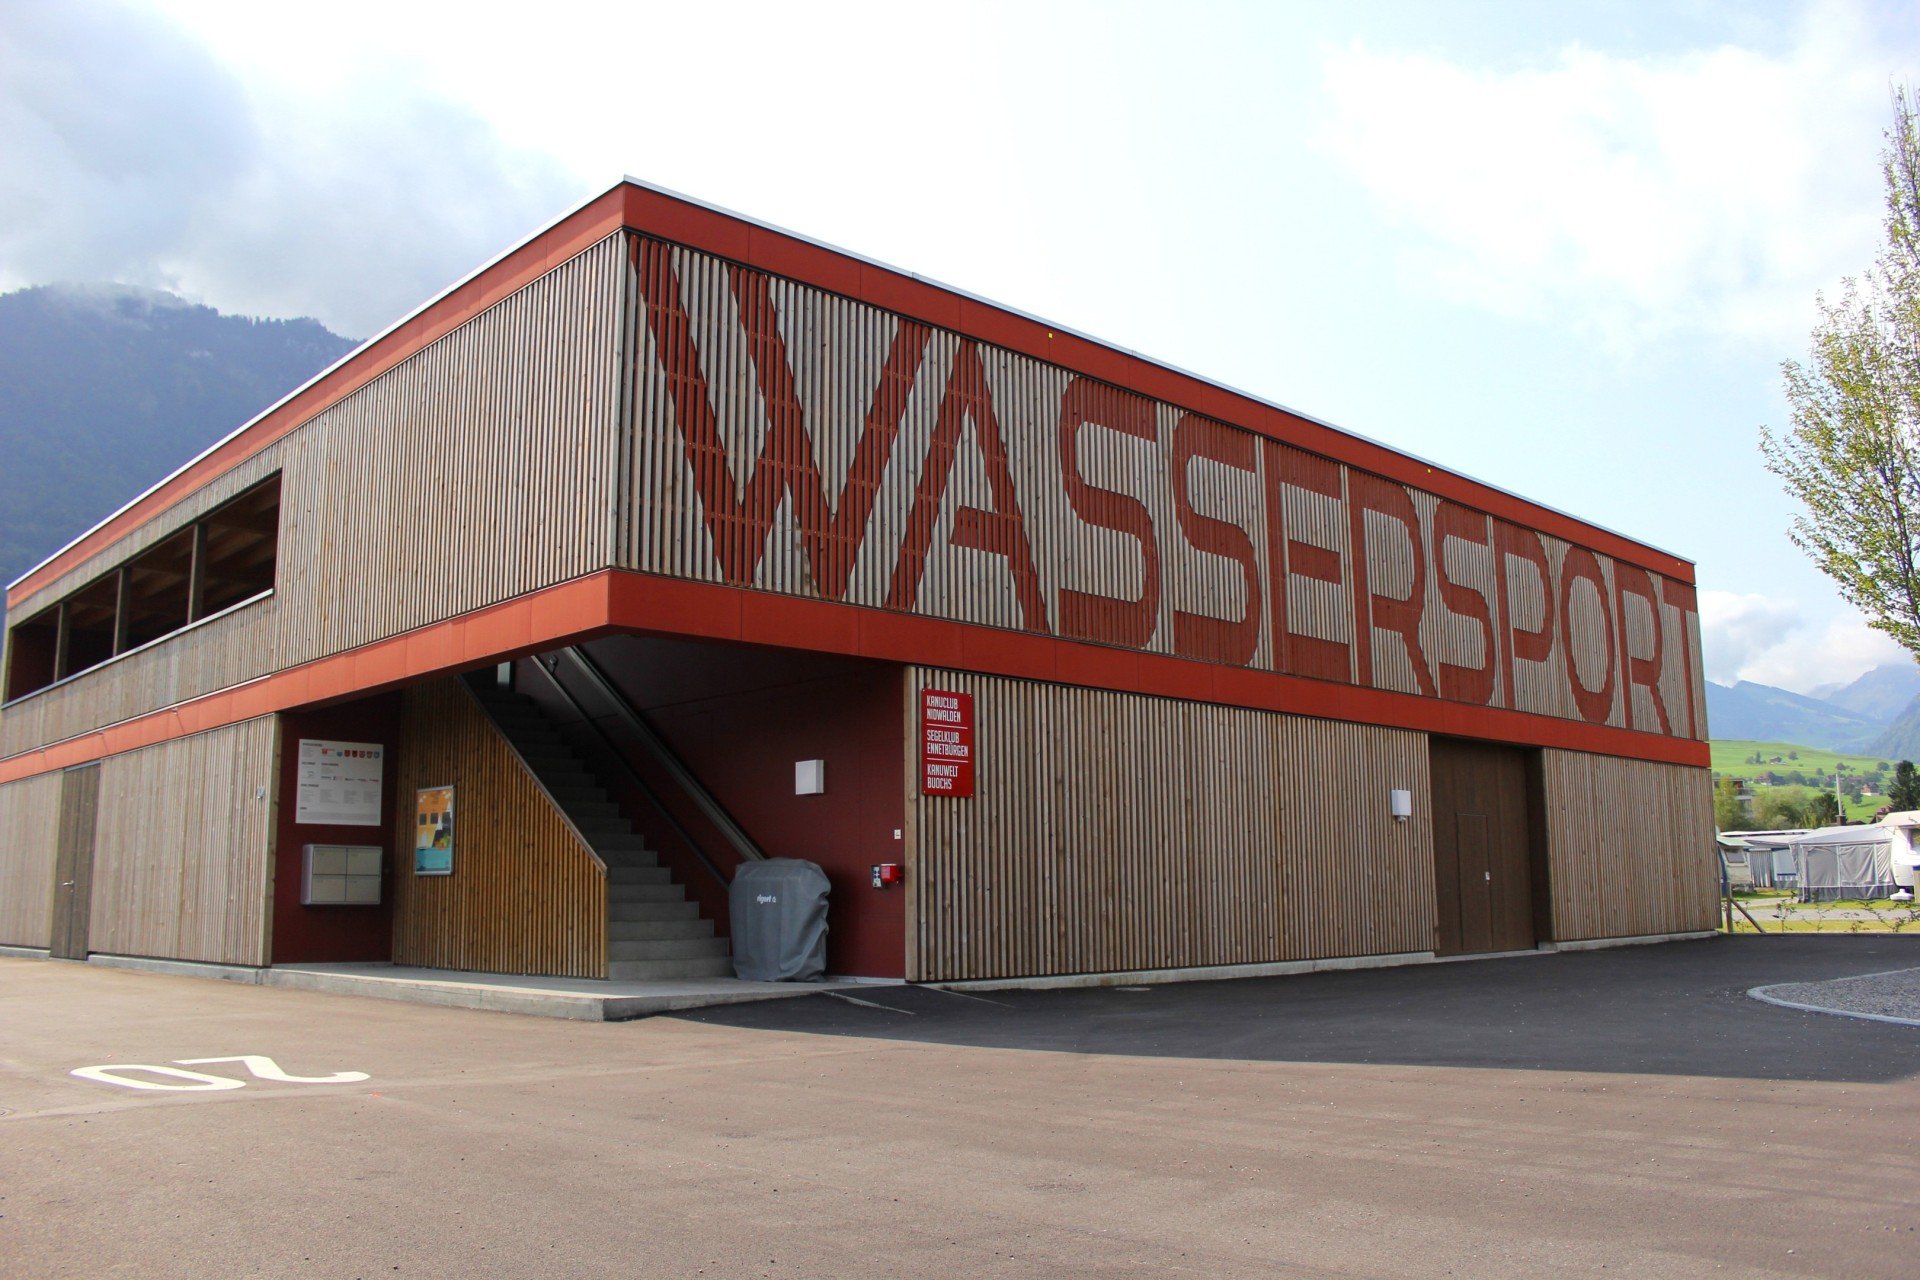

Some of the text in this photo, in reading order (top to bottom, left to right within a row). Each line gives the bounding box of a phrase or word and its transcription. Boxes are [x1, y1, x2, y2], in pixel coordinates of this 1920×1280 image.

[628, 233, 1699, 741] WASSERSPORT
[926, 695, 958, 709] KANUCLUB
[926, 708, 961, 722] NIDWALDEN
[926, 729, 960, 743] SEGELKLUB
[926, 743, 968, 757] ENNETBÜRGEN
[926, 763, 958, 777] KANUWELT
[927, 776, 952, 789] BUOCHS
